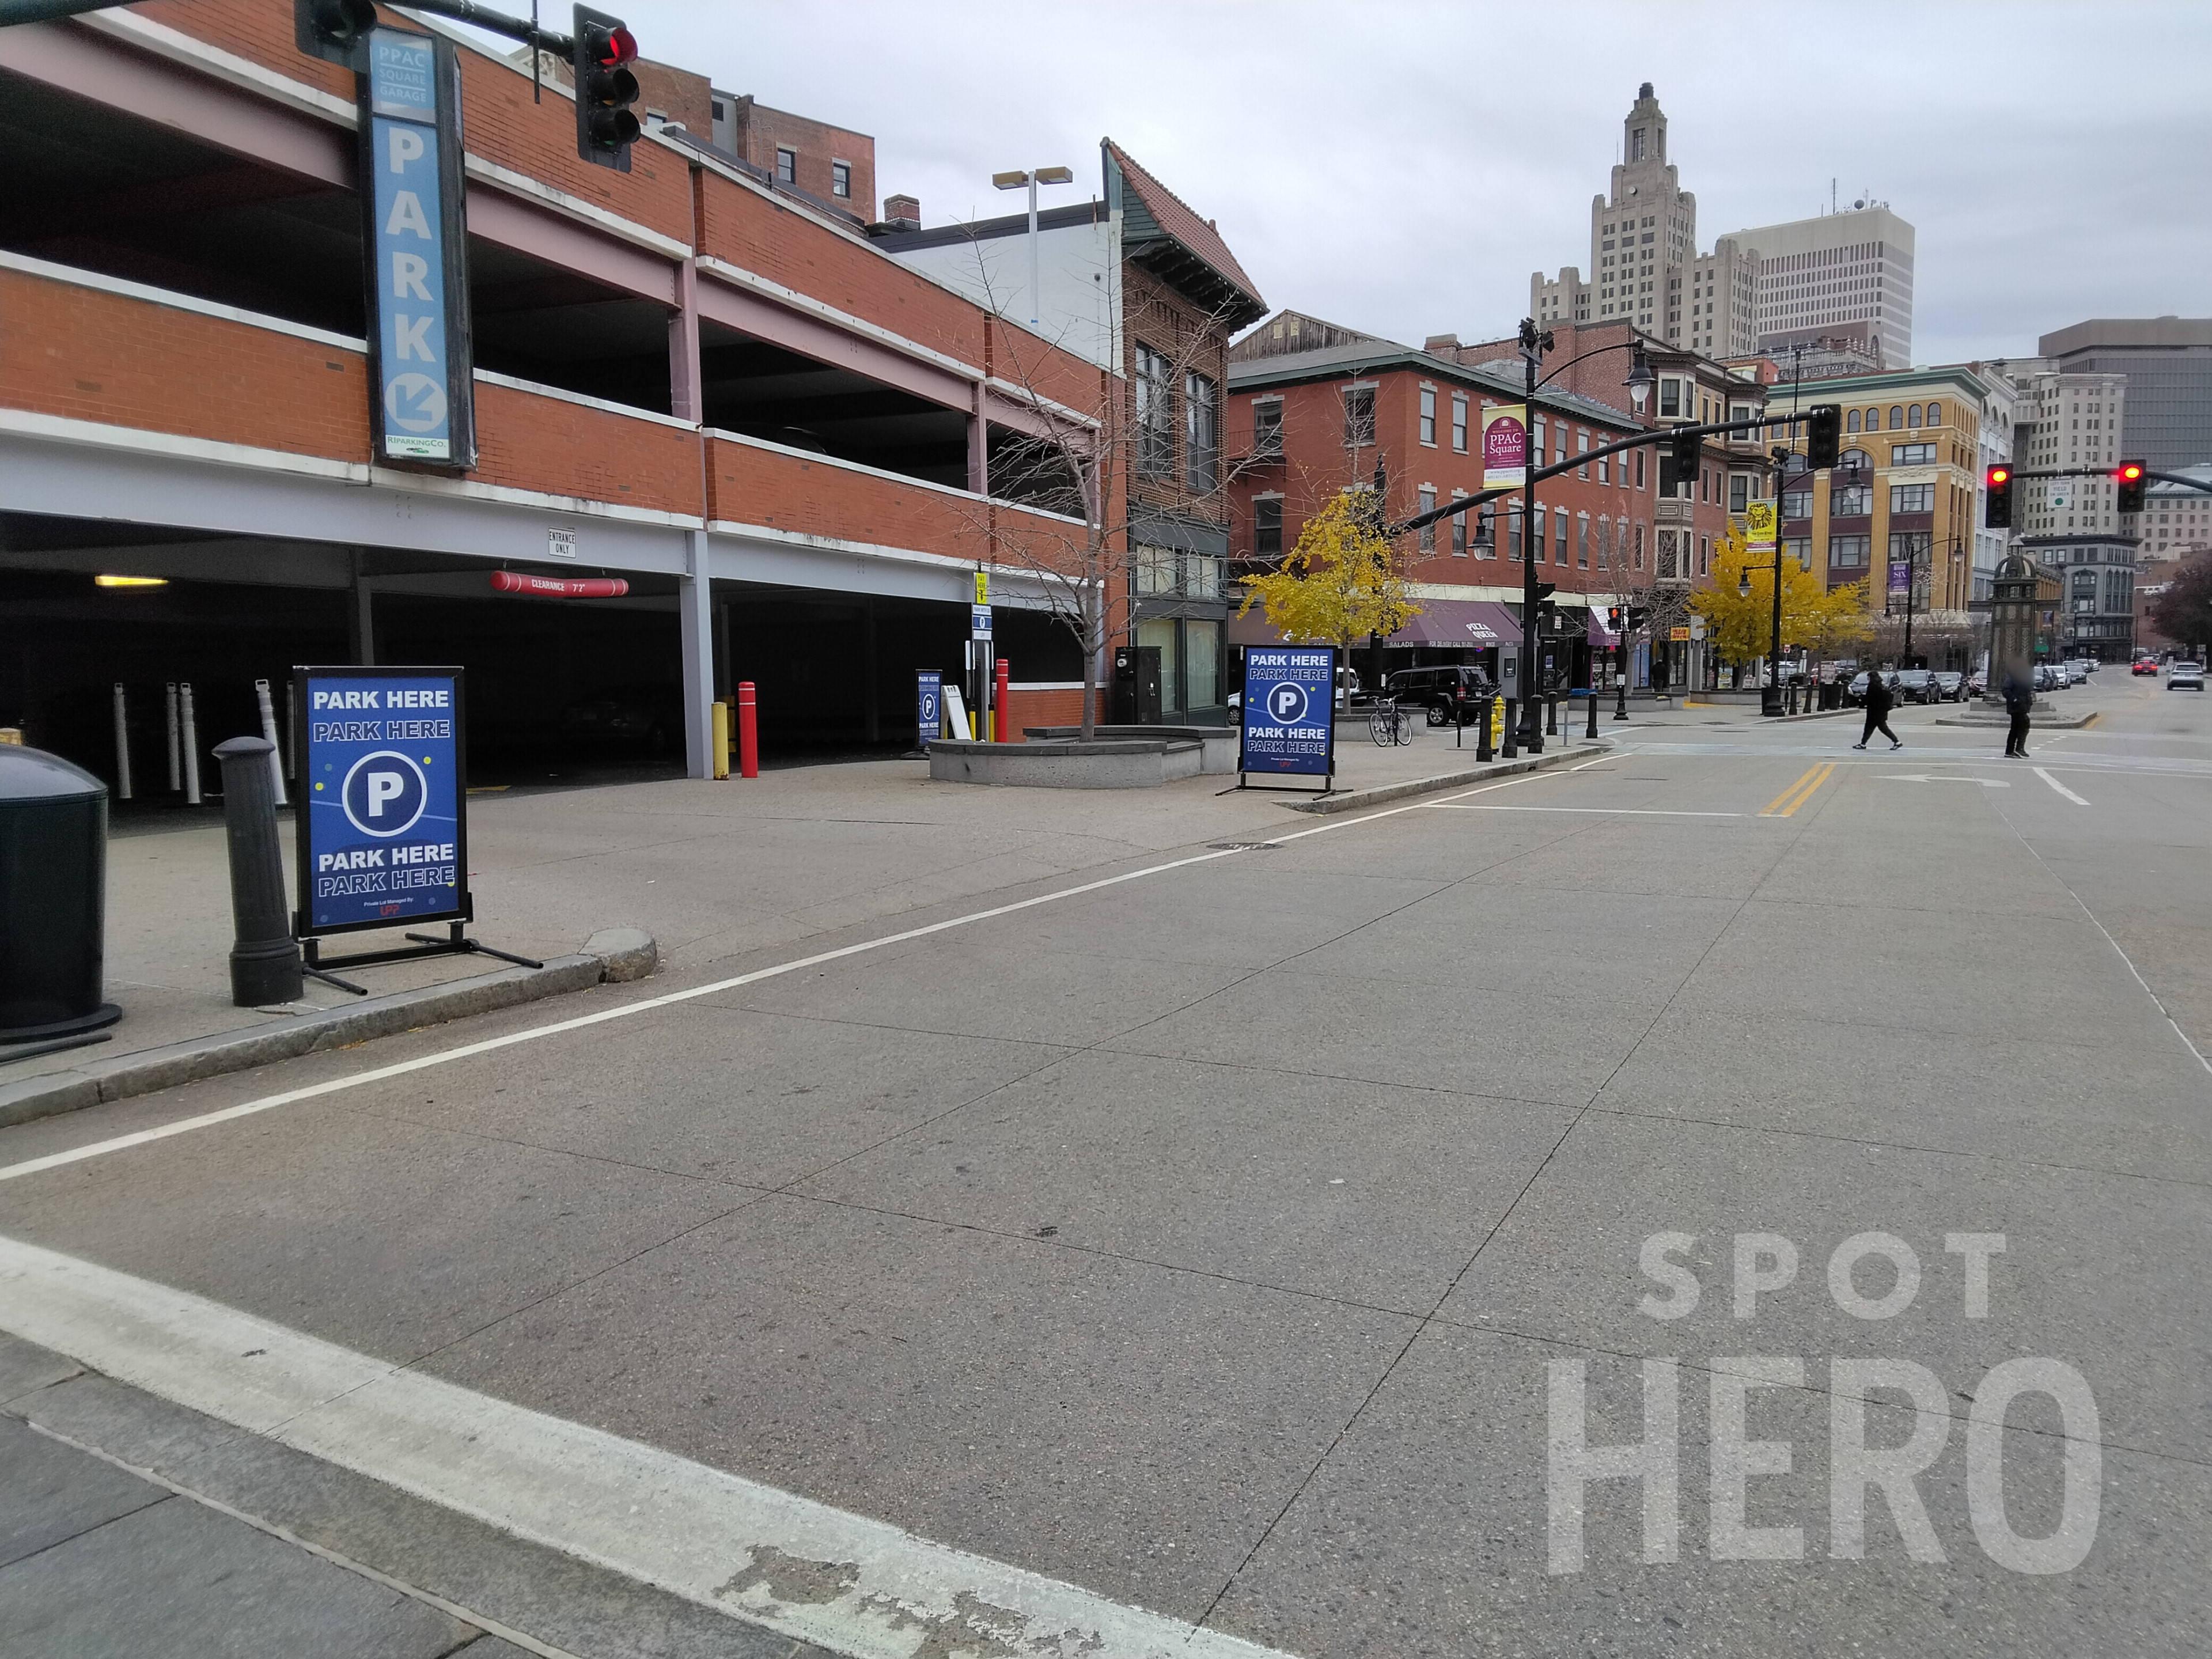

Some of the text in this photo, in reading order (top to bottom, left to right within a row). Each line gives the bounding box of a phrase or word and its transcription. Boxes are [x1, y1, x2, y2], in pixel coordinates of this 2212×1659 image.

[379, 46, 425, 67] PPAC
[379, 69, 426, 85] SQUARE
[380, 86, 426, 103] GARAGE
[385, 126, 436, 362] PARK
[1490, 433, 1521, 445] PPAC
[1490, 445, 1521, 456] Square
[549, 531, 575, 544] ENTRANCE
[555, 543, 570, 554] ONLY
[532, 579, 565, 592] CLEARANCE
[1465, 623, 1491, 631] PIZZA
[1472, 631, 1498, 639] QUEEN
[1251, 655, 1328, 666] PARK HERE
[1249, 668, 1328, 681] PARK HERE
[313, 690, 449, 710] PARK HERE
[926, 700, 932, 714] P
[1278, 692, 1297, 714] P
[313, 719, 450, 742] PARK HERE
[1248, 727, 1325, 739] PARK HERE
[1247, 740, 1325, 754] PARK HERE
[368, 772, 404, 817] P
[319, 843, 454, 872] PARK HERE
[319, 866, 455, 897] PARK HERE
